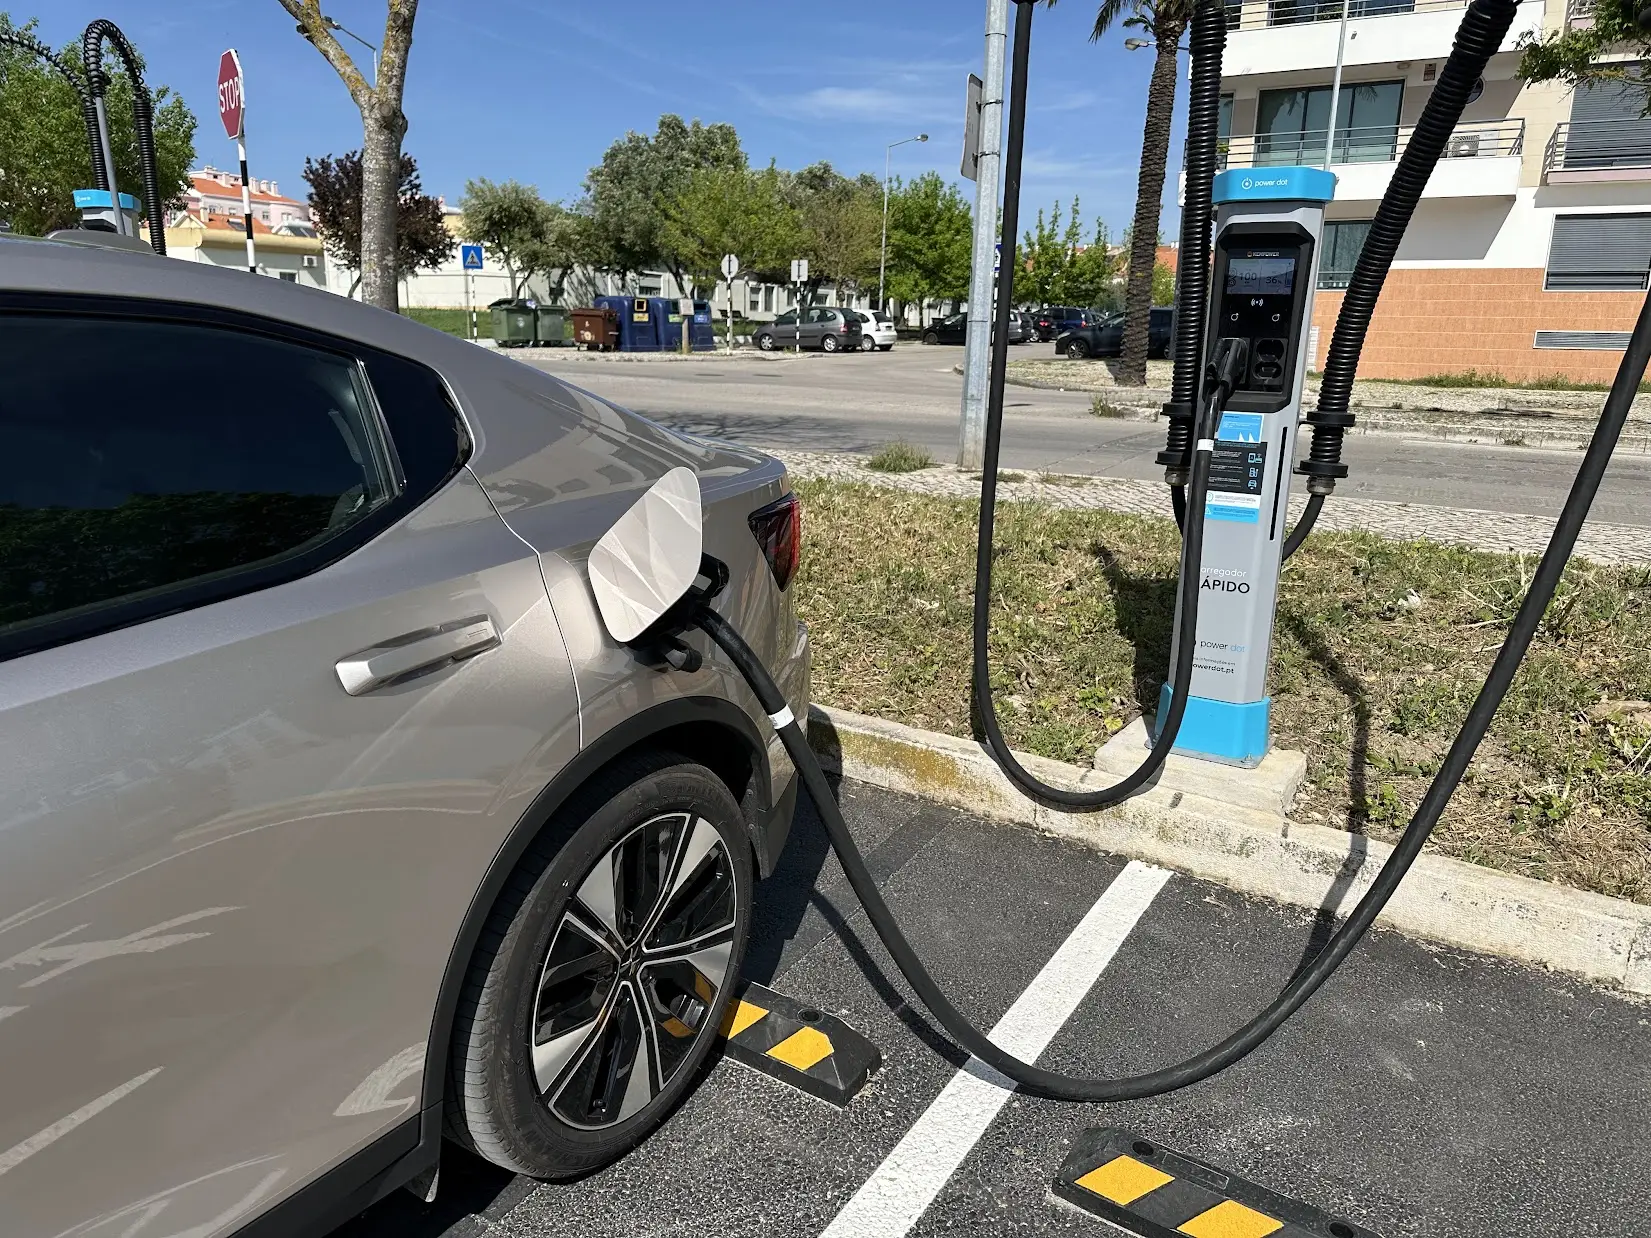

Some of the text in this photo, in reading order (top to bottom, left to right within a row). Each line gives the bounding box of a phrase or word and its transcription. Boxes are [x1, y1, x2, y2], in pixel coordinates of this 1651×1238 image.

[219, 76, 240, 114] STOP
[1254, 178, 1288, 188] power dot
[1240, 272, 1257, 281] 100
[1200, 567, 1247, 577] arregador
[1200, 575, 1250, 594] ÁPIDO
[1200, 641, 1246, 653] power dot
[1192, 663, 1235, 674] owerdot.pt
